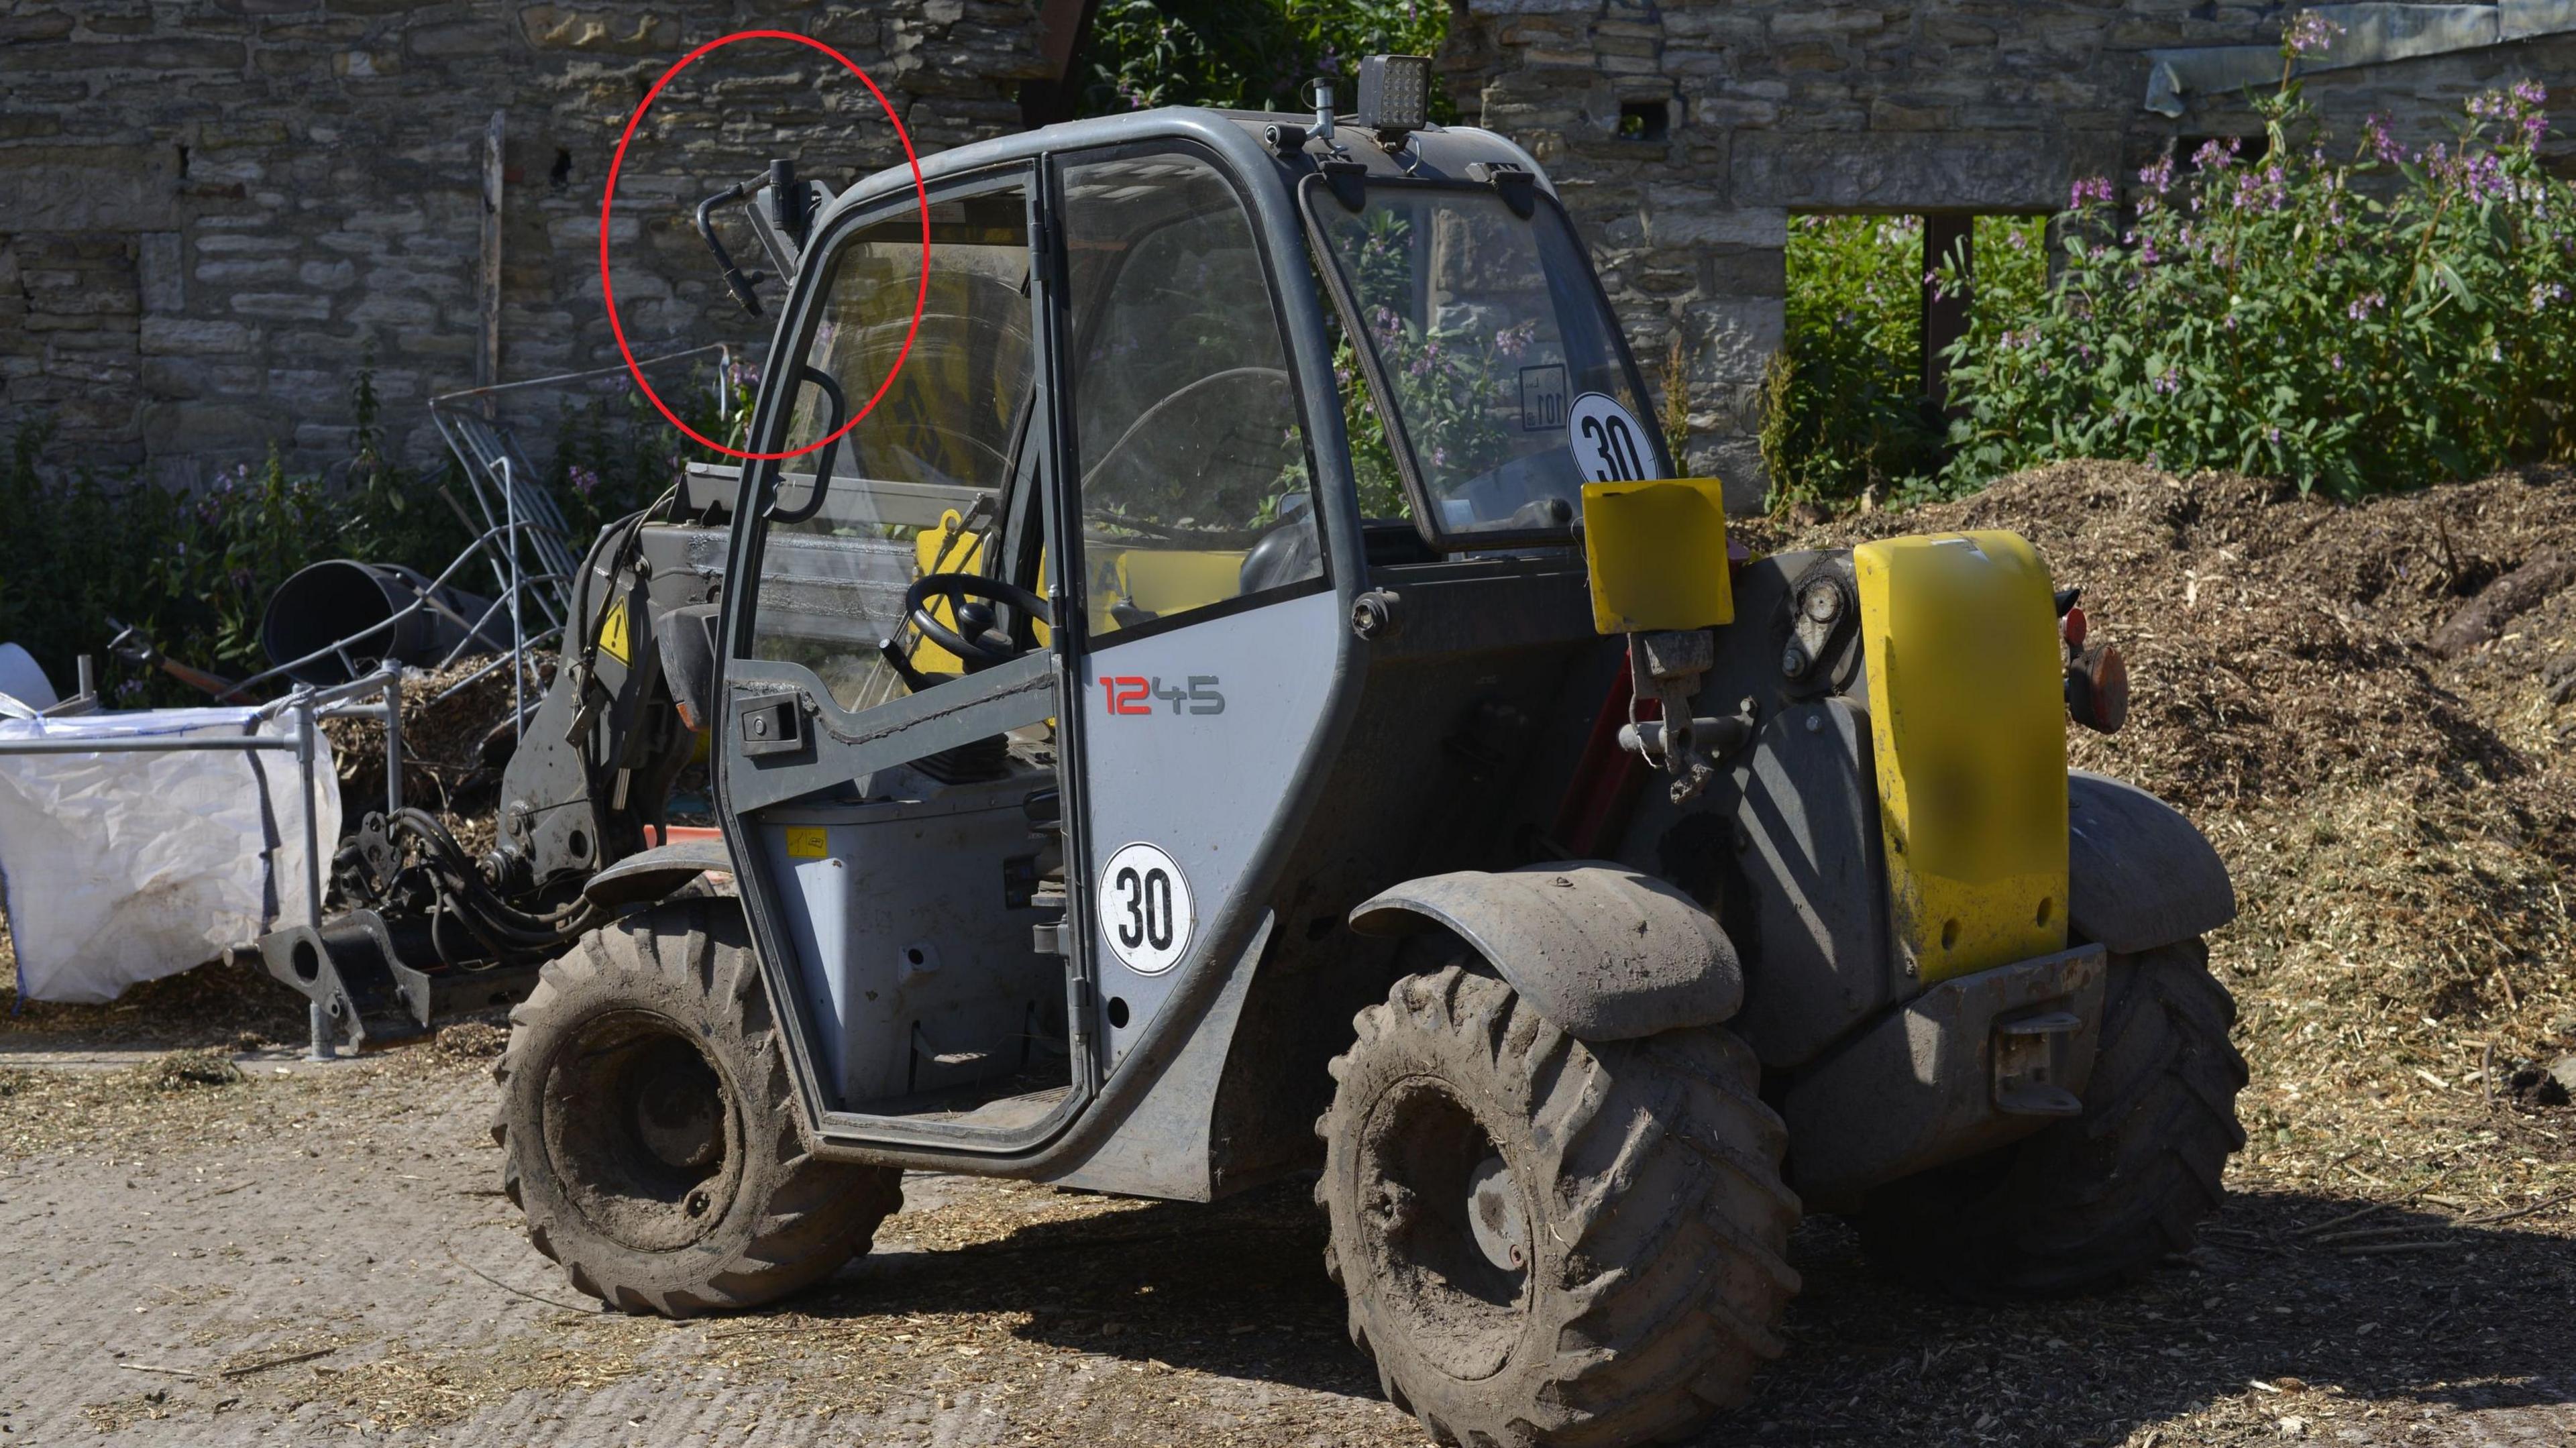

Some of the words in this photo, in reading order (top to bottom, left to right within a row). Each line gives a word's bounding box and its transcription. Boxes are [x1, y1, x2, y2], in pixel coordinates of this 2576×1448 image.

[1581, 414, 1644, 482] 30
[1099, 675, 1226, 715] 1245
[1116, 867, 1173, 951] 30
